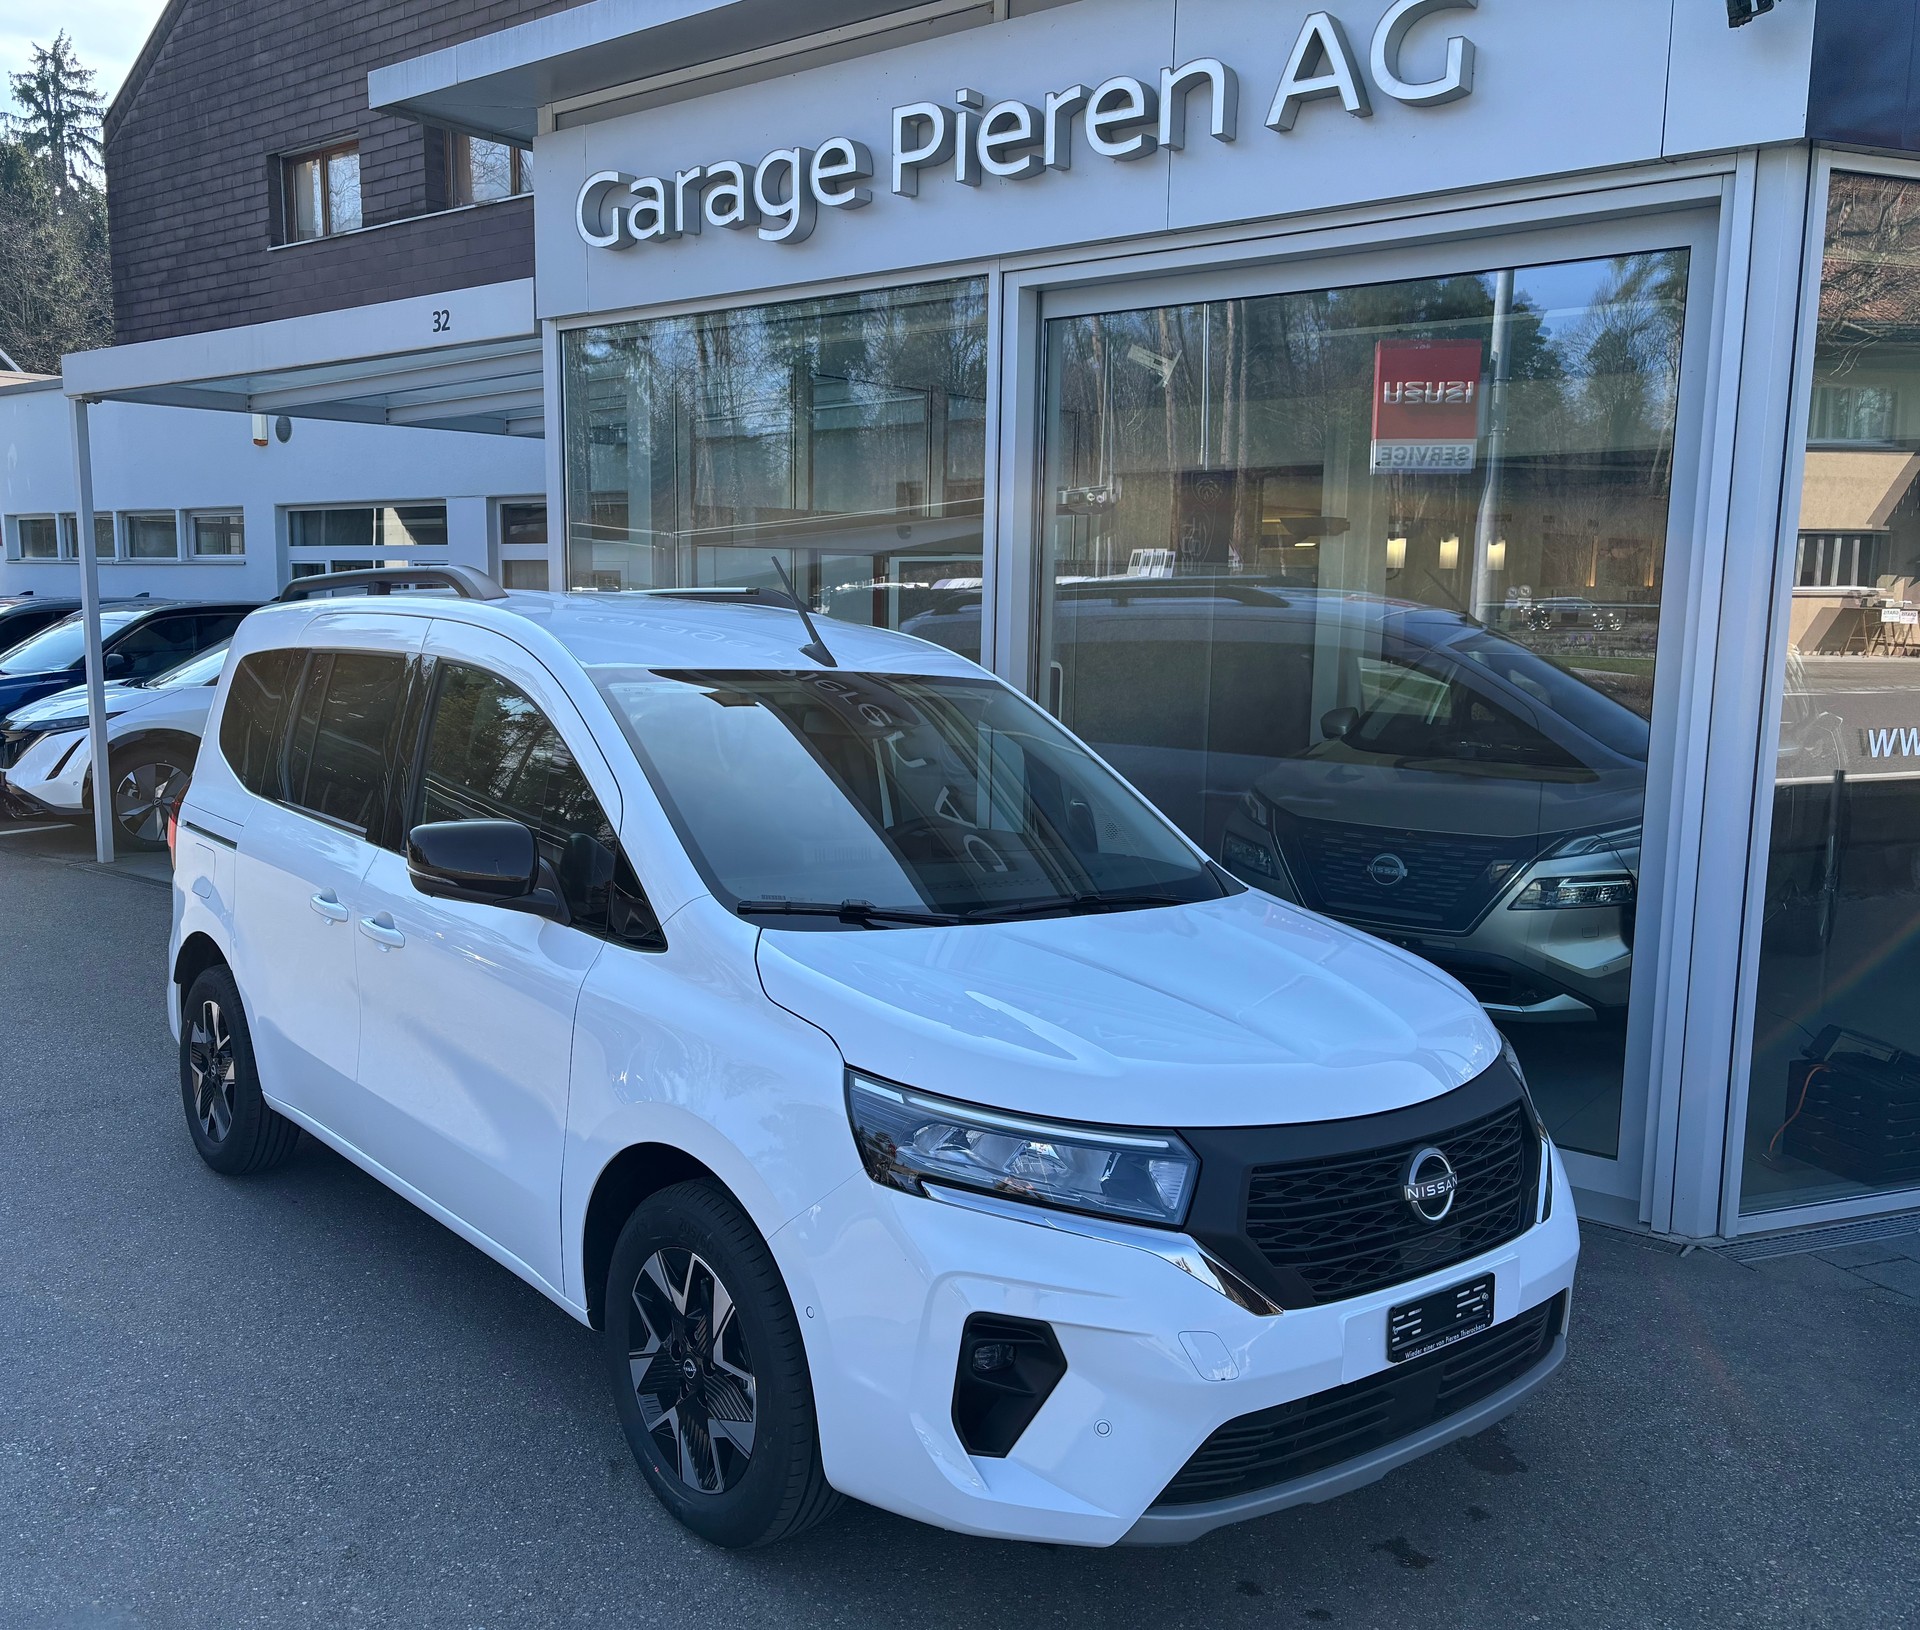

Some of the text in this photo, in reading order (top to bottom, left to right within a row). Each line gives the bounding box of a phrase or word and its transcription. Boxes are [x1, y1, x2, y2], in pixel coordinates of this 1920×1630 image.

[575, 0, 1476, 251] Garage Pieren AG
[432, 309, 451, 333] 32
[1406, 1173, 1459, 1200] NISSAN
[1404, 1347, 1422, 1359] Wieder
[1423, 1343, 1436, 1352] einer
[1445, 1333, 1460, 1344] Pieren
